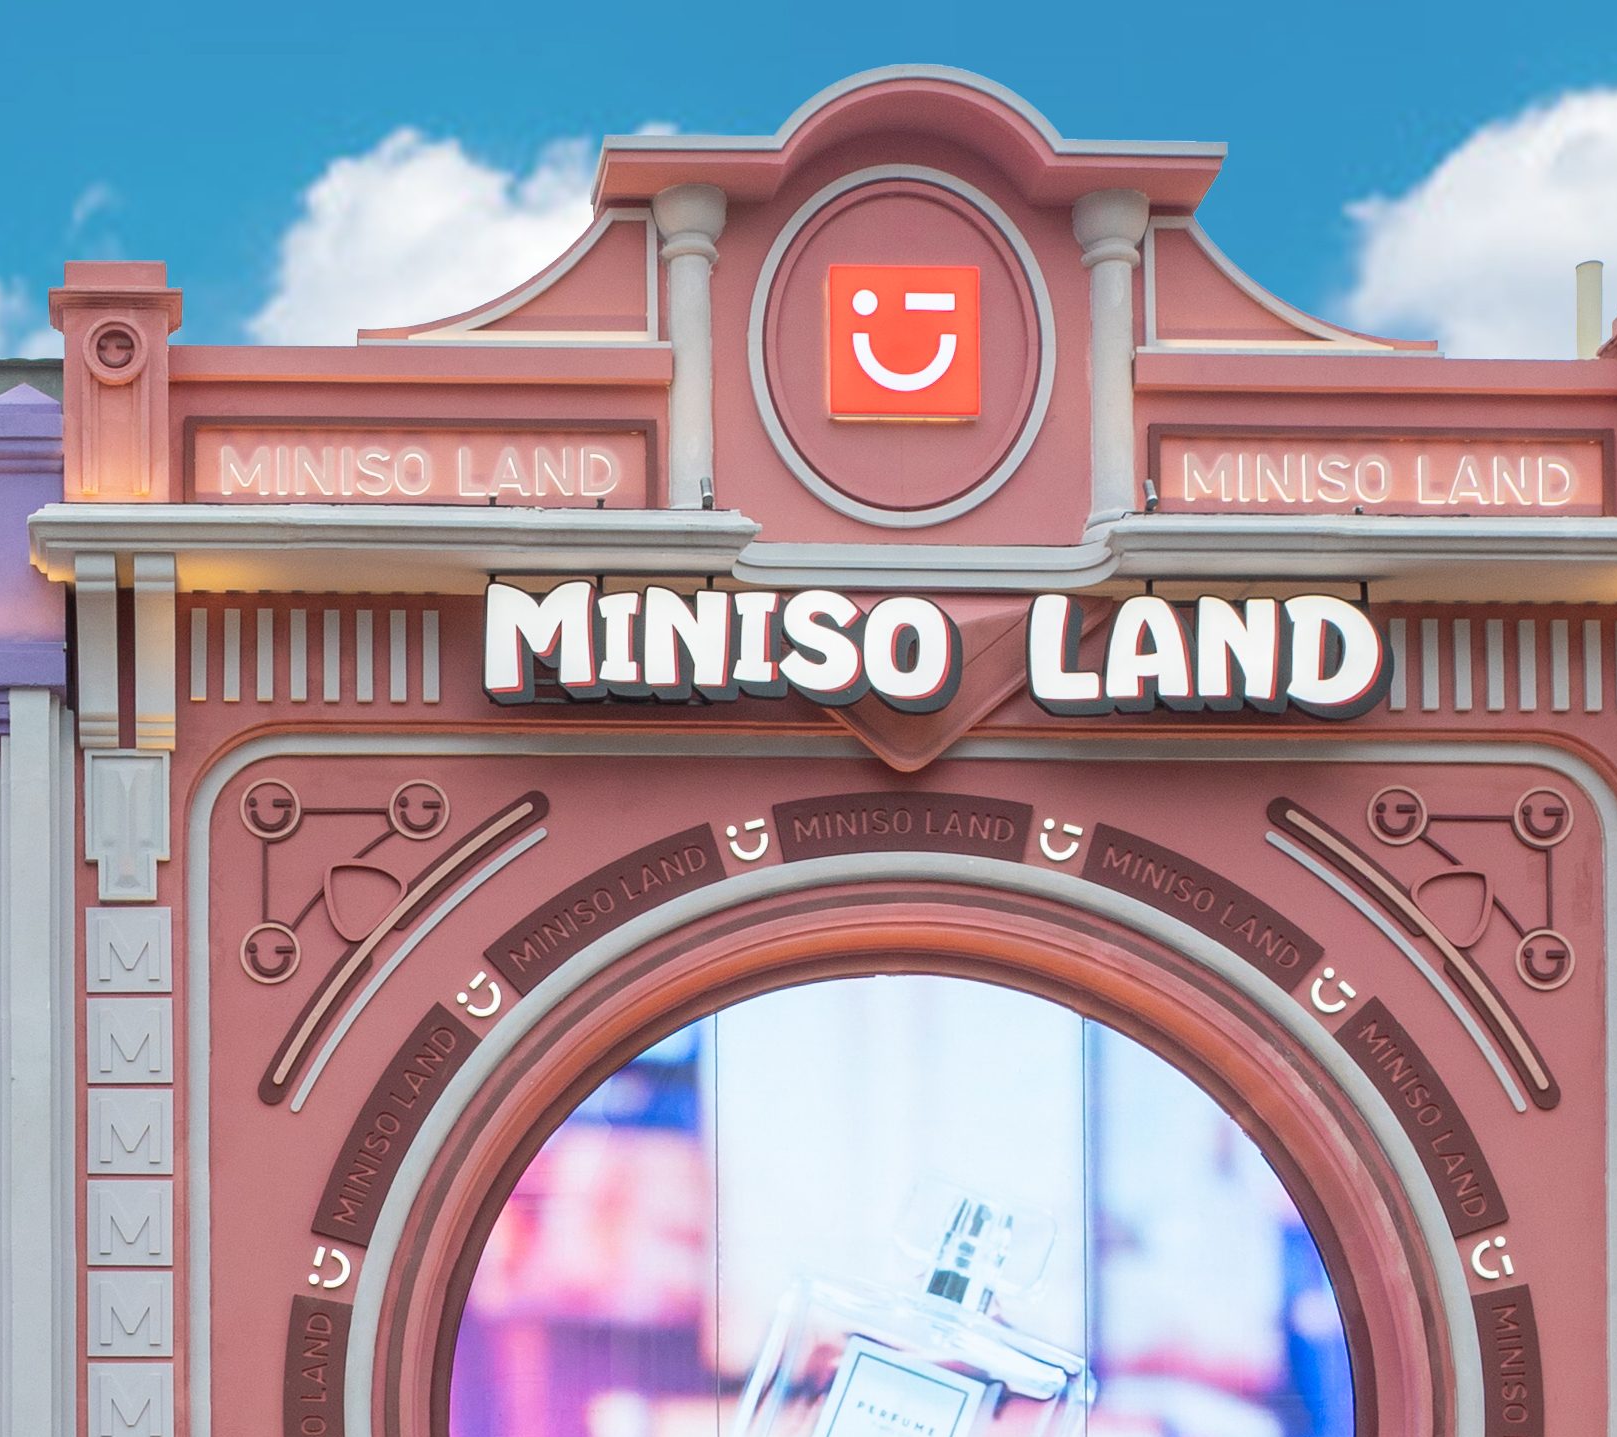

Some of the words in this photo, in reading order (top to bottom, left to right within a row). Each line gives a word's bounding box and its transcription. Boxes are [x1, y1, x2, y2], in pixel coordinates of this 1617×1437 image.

[219, 445, 433, 498] MINISO
[457, 446, 622, 499] LAND
[1183, 451, 1392, 503] MINISO
[1417, 454, 1577, 508] LAND
[482, 580, 961, 714] MINISO
[1027, 594, 1394, 720] LAND
[794, 809, 915, 845] MINISO
[926, 809, 1016, 843] LAND
[509, 888, 616, 972] MINISO
[619, 844, 708, 898] LAND
[1102, 844, 1215, 913] MINISO
[1218, 905, 1303, 972] LAND
[335, 1111, 402, 1225] MINISO
[394, 1025, 457, 1113] LAND
[857, 1401, 935, 1436] PERFUME
